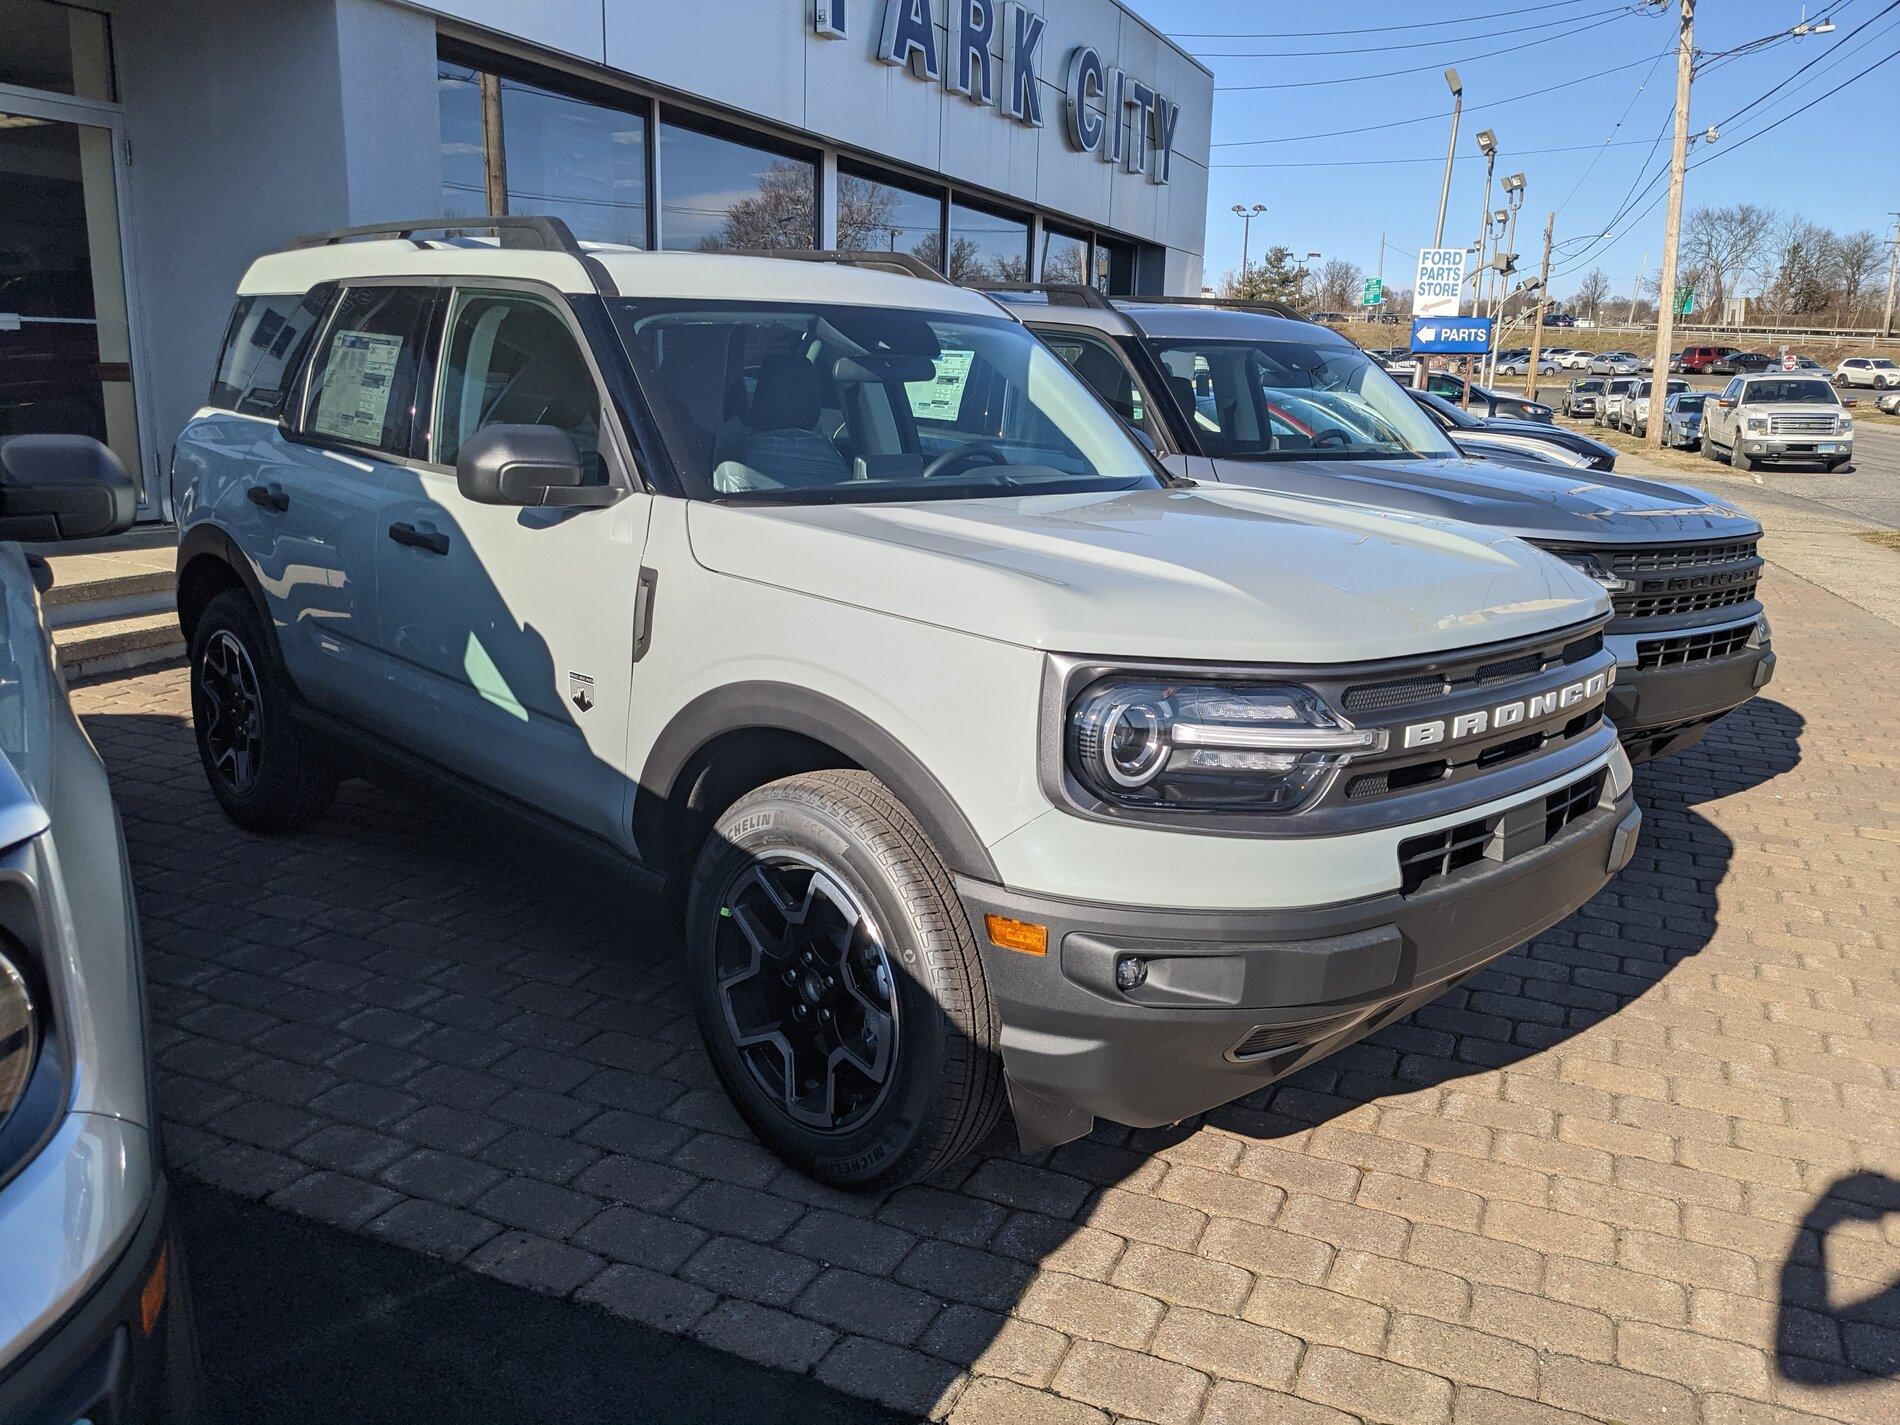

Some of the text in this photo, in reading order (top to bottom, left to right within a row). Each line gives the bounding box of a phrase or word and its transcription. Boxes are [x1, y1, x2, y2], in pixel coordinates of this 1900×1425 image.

[815, 0, 1180, 185] ARK CITY
[1421, 251, 1462, 265] FORD
[1419, 267, 1461, 282] PARTS
[1417, 282, 1459, 297] STORE
[1440, 328, 1487, 342] PARTS
[1403, 673, 1605, 748] BRONCO
